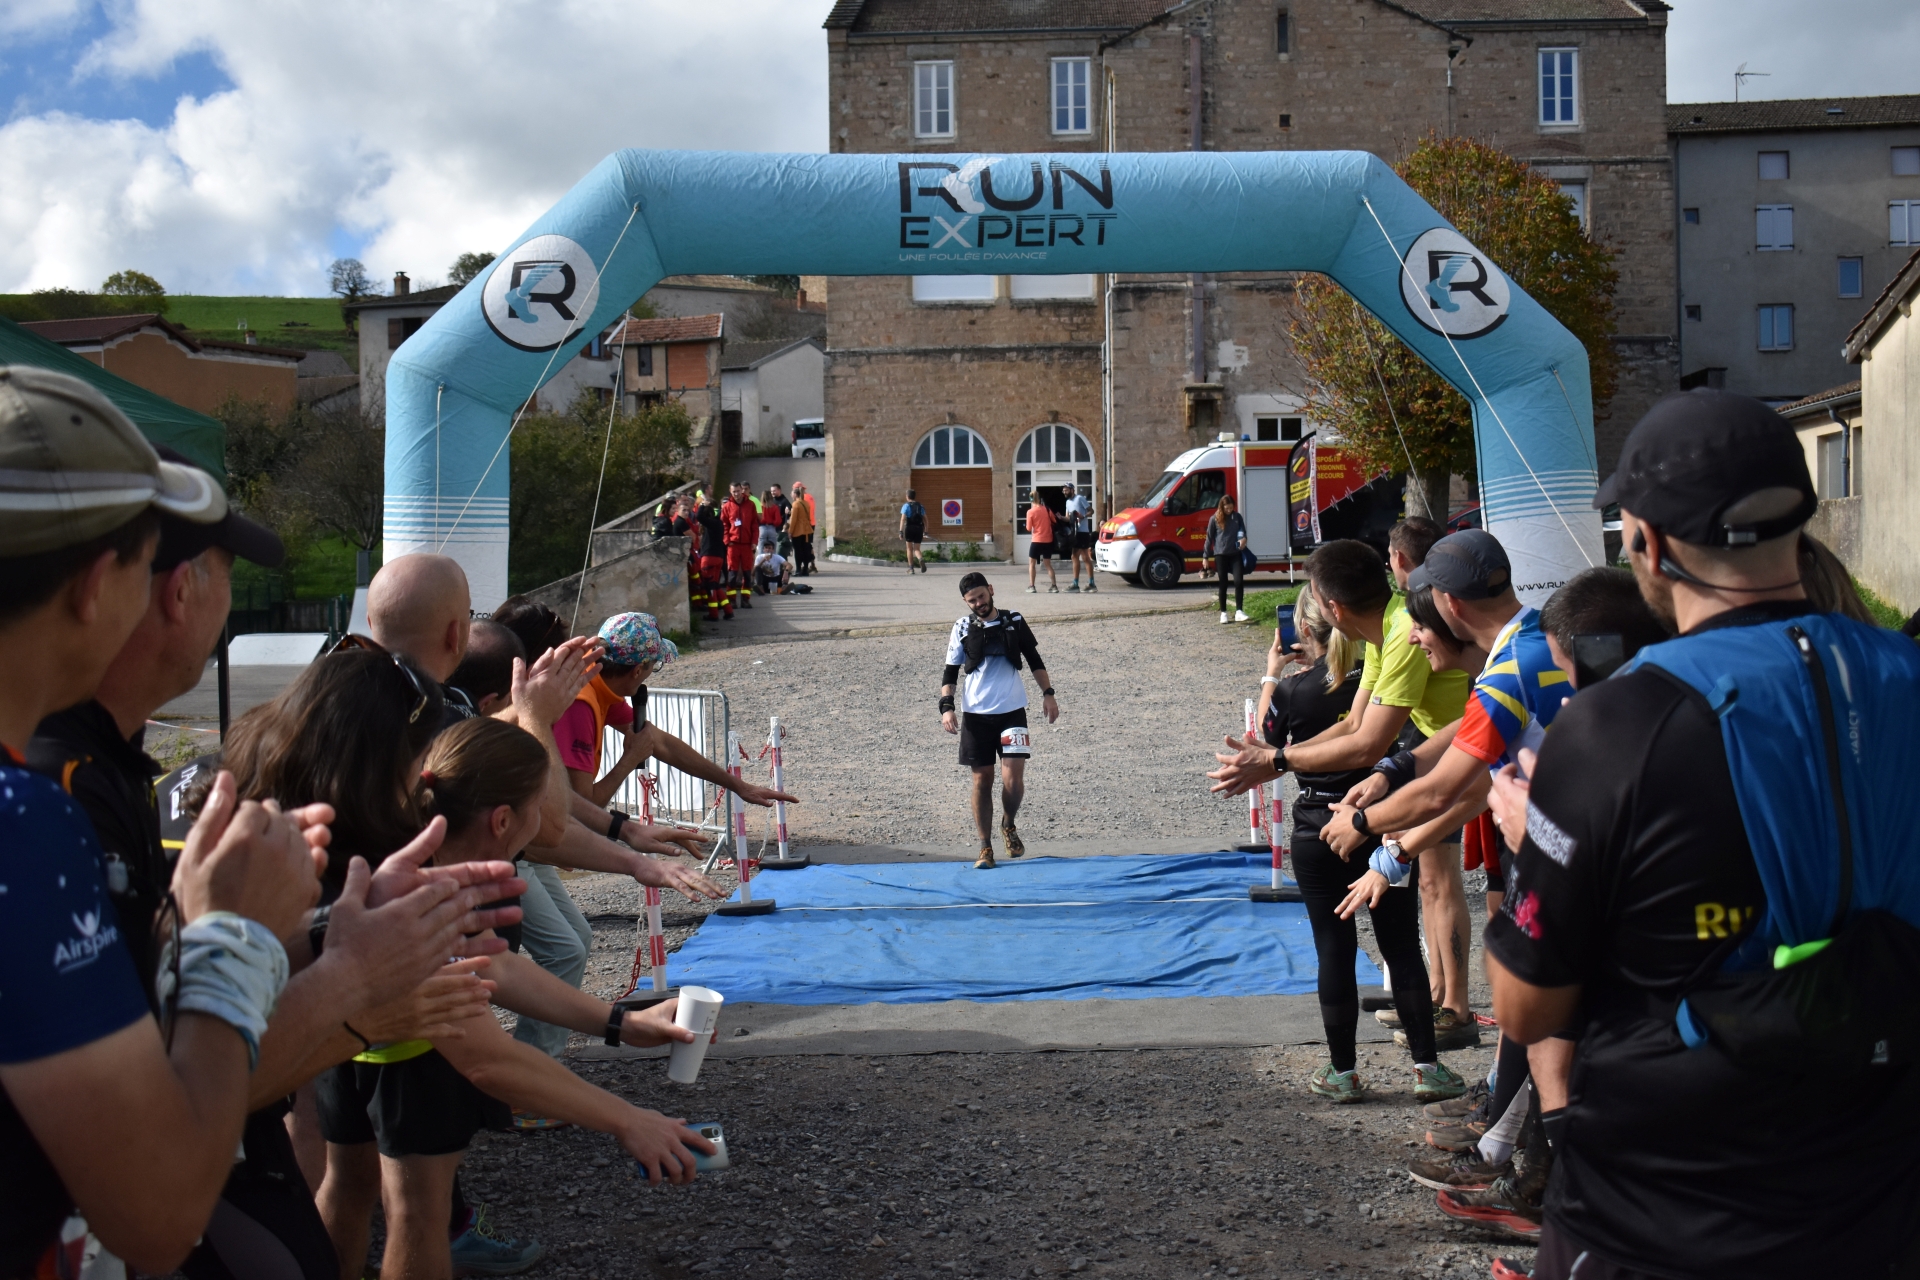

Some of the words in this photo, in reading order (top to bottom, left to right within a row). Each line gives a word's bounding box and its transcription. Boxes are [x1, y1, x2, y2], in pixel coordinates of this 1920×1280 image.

[898, 159, 1114, 213] RUN
[900, 213, 1118, 249] EXPERT
[898, 253, 926, 262] UNE
[929, 251, 980, 261] FOULÉE
[983, 251, 1048, 261] D'AVANCE
[1848, 709, 1861, 764] VADICT
